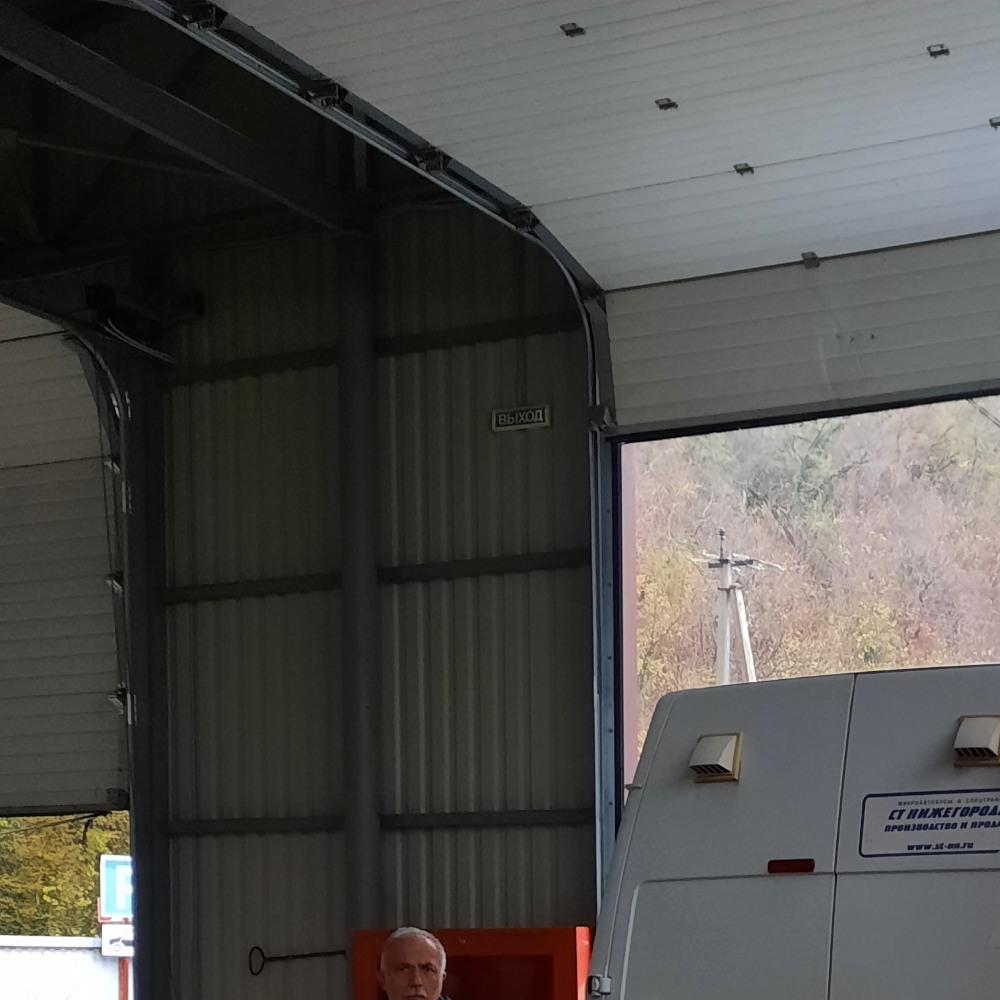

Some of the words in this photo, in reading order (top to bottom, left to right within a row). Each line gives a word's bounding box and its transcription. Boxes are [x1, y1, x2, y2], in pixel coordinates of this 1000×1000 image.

[498, 409, 544, 425] ВЫХОД
[888, 809, 906, 821] СТ
[884, 822, 957, 832] ПРОИЗВОДСТВО
[960, 821, 968, 830] И
